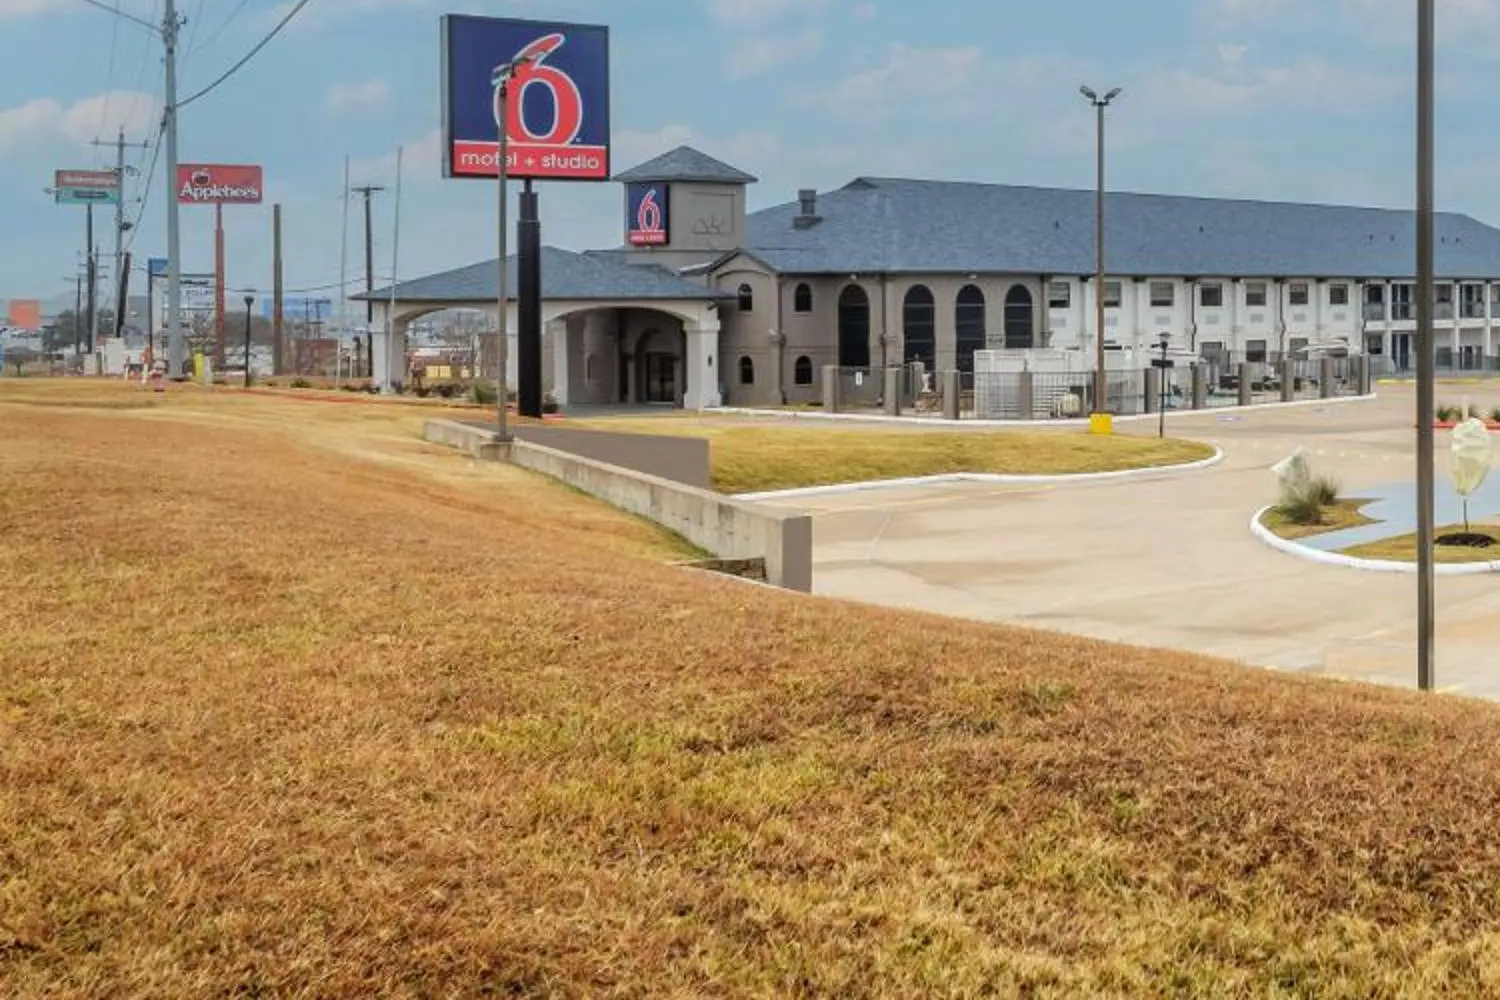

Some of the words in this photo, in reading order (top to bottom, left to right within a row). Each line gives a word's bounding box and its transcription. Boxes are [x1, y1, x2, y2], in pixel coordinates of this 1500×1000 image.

[494, 32, 583, 146] 6
[541, 153, 599, 169] studio
[638, 188, 661, 232] 6
